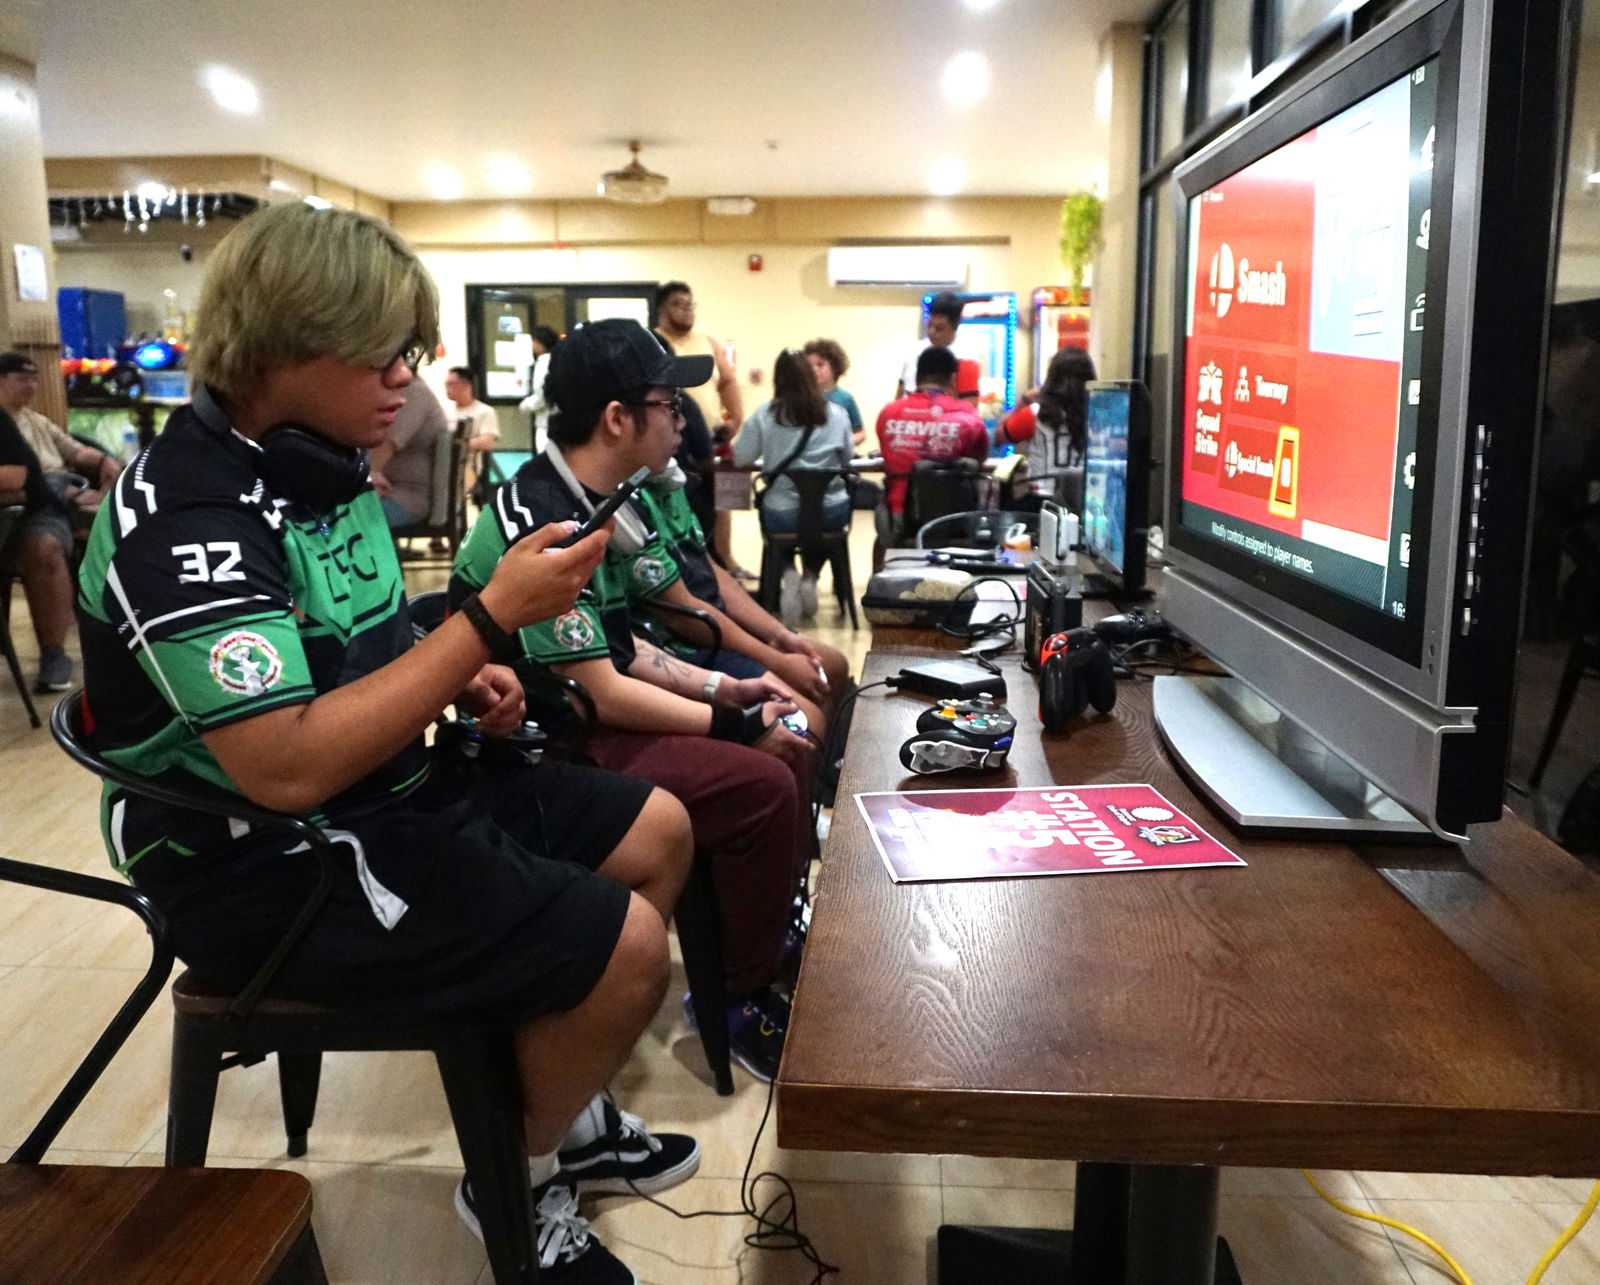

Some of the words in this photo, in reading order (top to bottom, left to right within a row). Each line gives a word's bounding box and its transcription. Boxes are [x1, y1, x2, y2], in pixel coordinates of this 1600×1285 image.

[1237, 258, 1286, 306] Smash
[885, 419, 960, 438] SERVICE
[1196, 408, 1221, 433] Squad
[1195, 432, 1219, 456] Strike
[171, 540, 247, 584] 32
[1211, 521, 1226, 542] Modify
[1226, 529, 1244, 546] controls
[1245, 535, 1266, 554] assigned
[1267, 541, 1273, 557] to
[1273, 544, 1291, 566] player
[1291, 553, 1313, 574] names.
[986, 810, 1081, 848] #5
[1040, 791, 1144, 866] STATION
